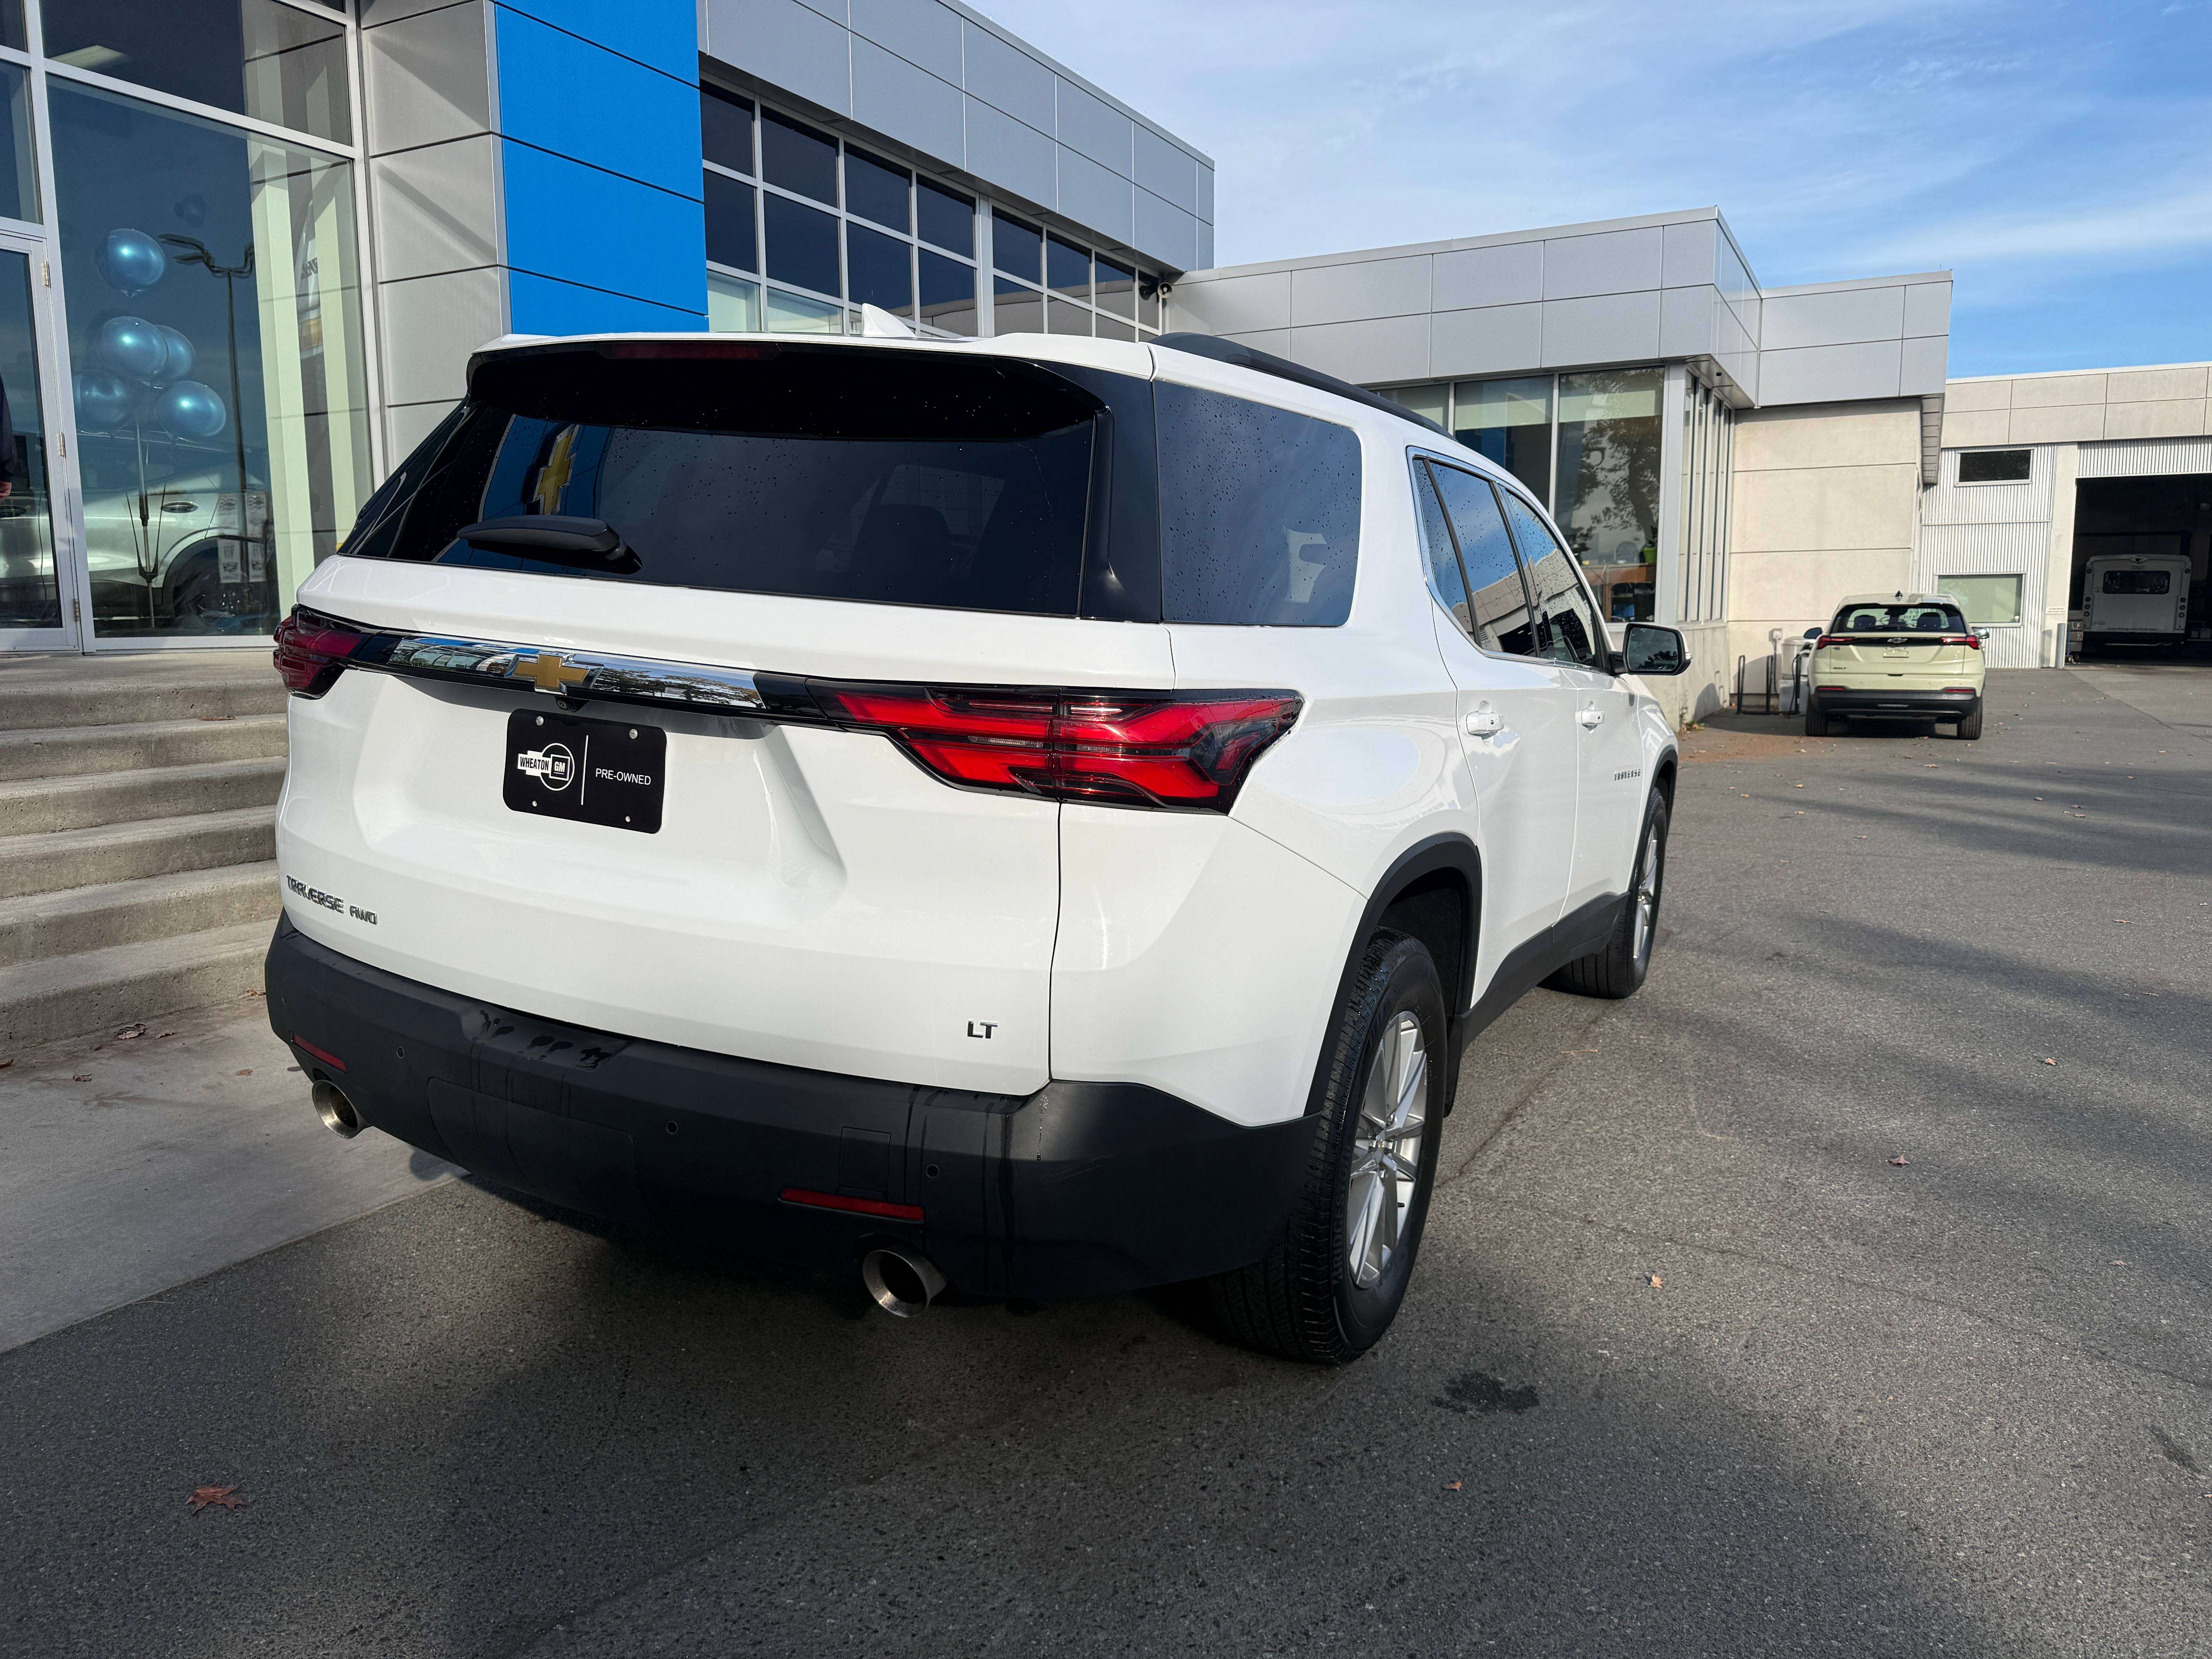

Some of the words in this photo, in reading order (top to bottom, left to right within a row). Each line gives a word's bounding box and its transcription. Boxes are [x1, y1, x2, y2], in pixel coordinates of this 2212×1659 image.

[520, 756, 549, 771] WHEATON
[554, 761, 565, 773] GM
[596, 768, 651, 785] PRE-OWNED
[287, 875, 344, 914] TRAVERSE
[350, 905, 378, 925] AWD
[967, 1020, 998, 1039] LT
